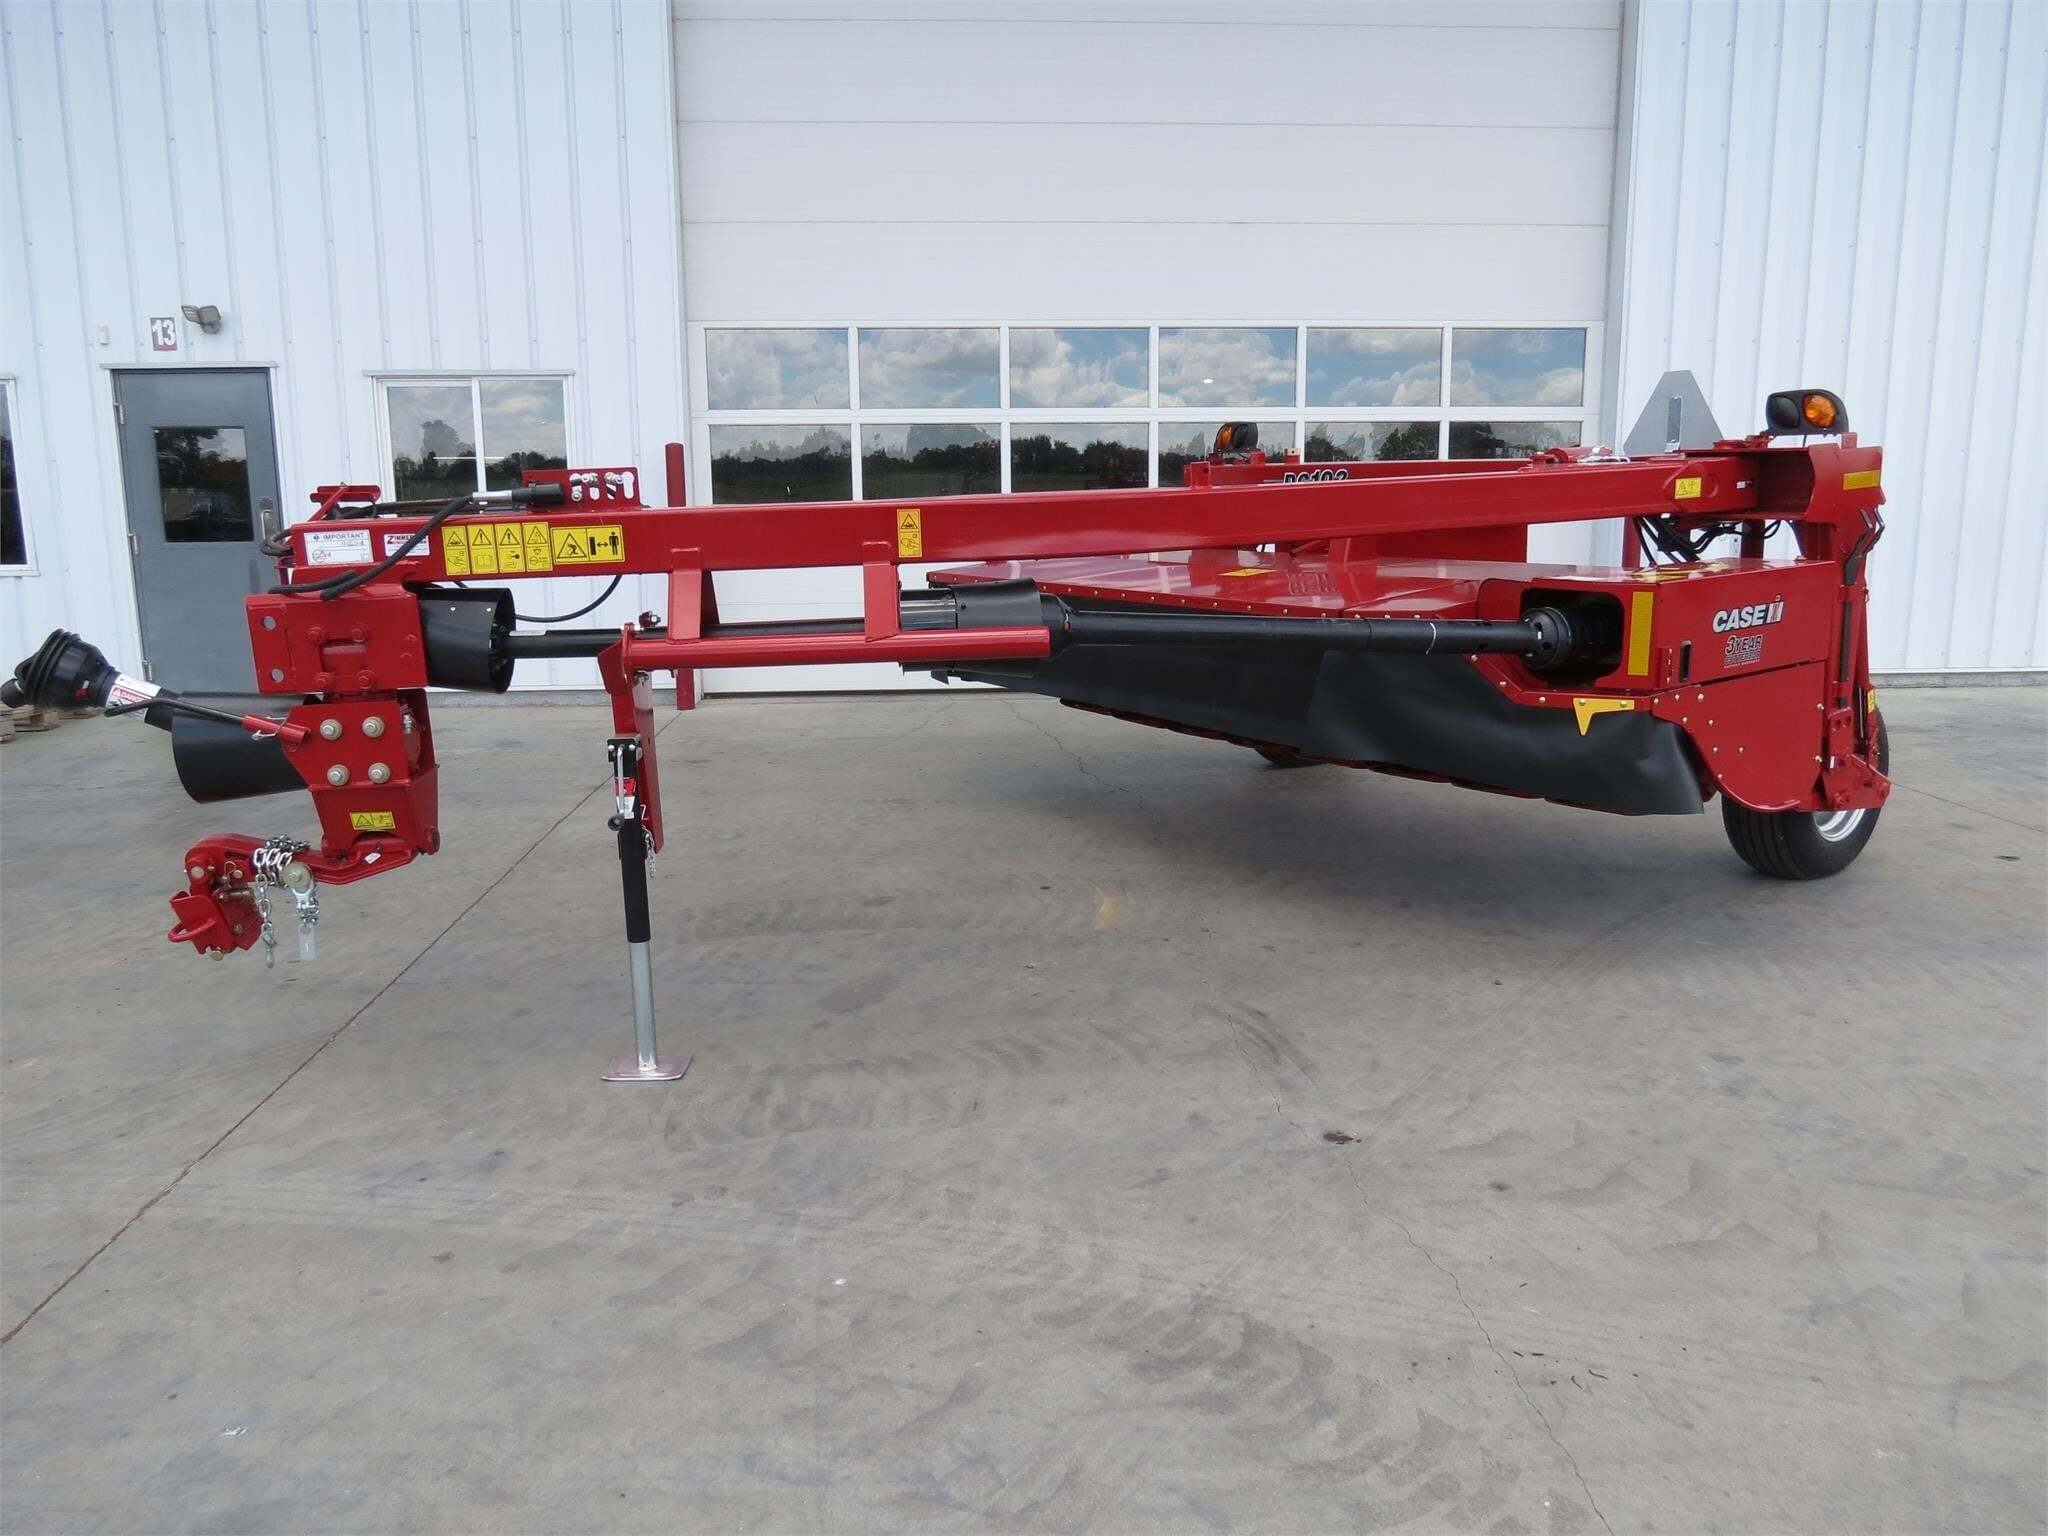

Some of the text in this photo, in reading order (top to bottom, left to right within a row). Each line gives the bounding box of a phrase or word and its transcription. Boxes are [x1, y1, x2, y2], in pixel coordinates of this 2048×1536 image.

[152, 320, 176, 346] 13
[322, 532, 364, 541] IMPORTANT
[1713, 604, 1766, 633] CASE
